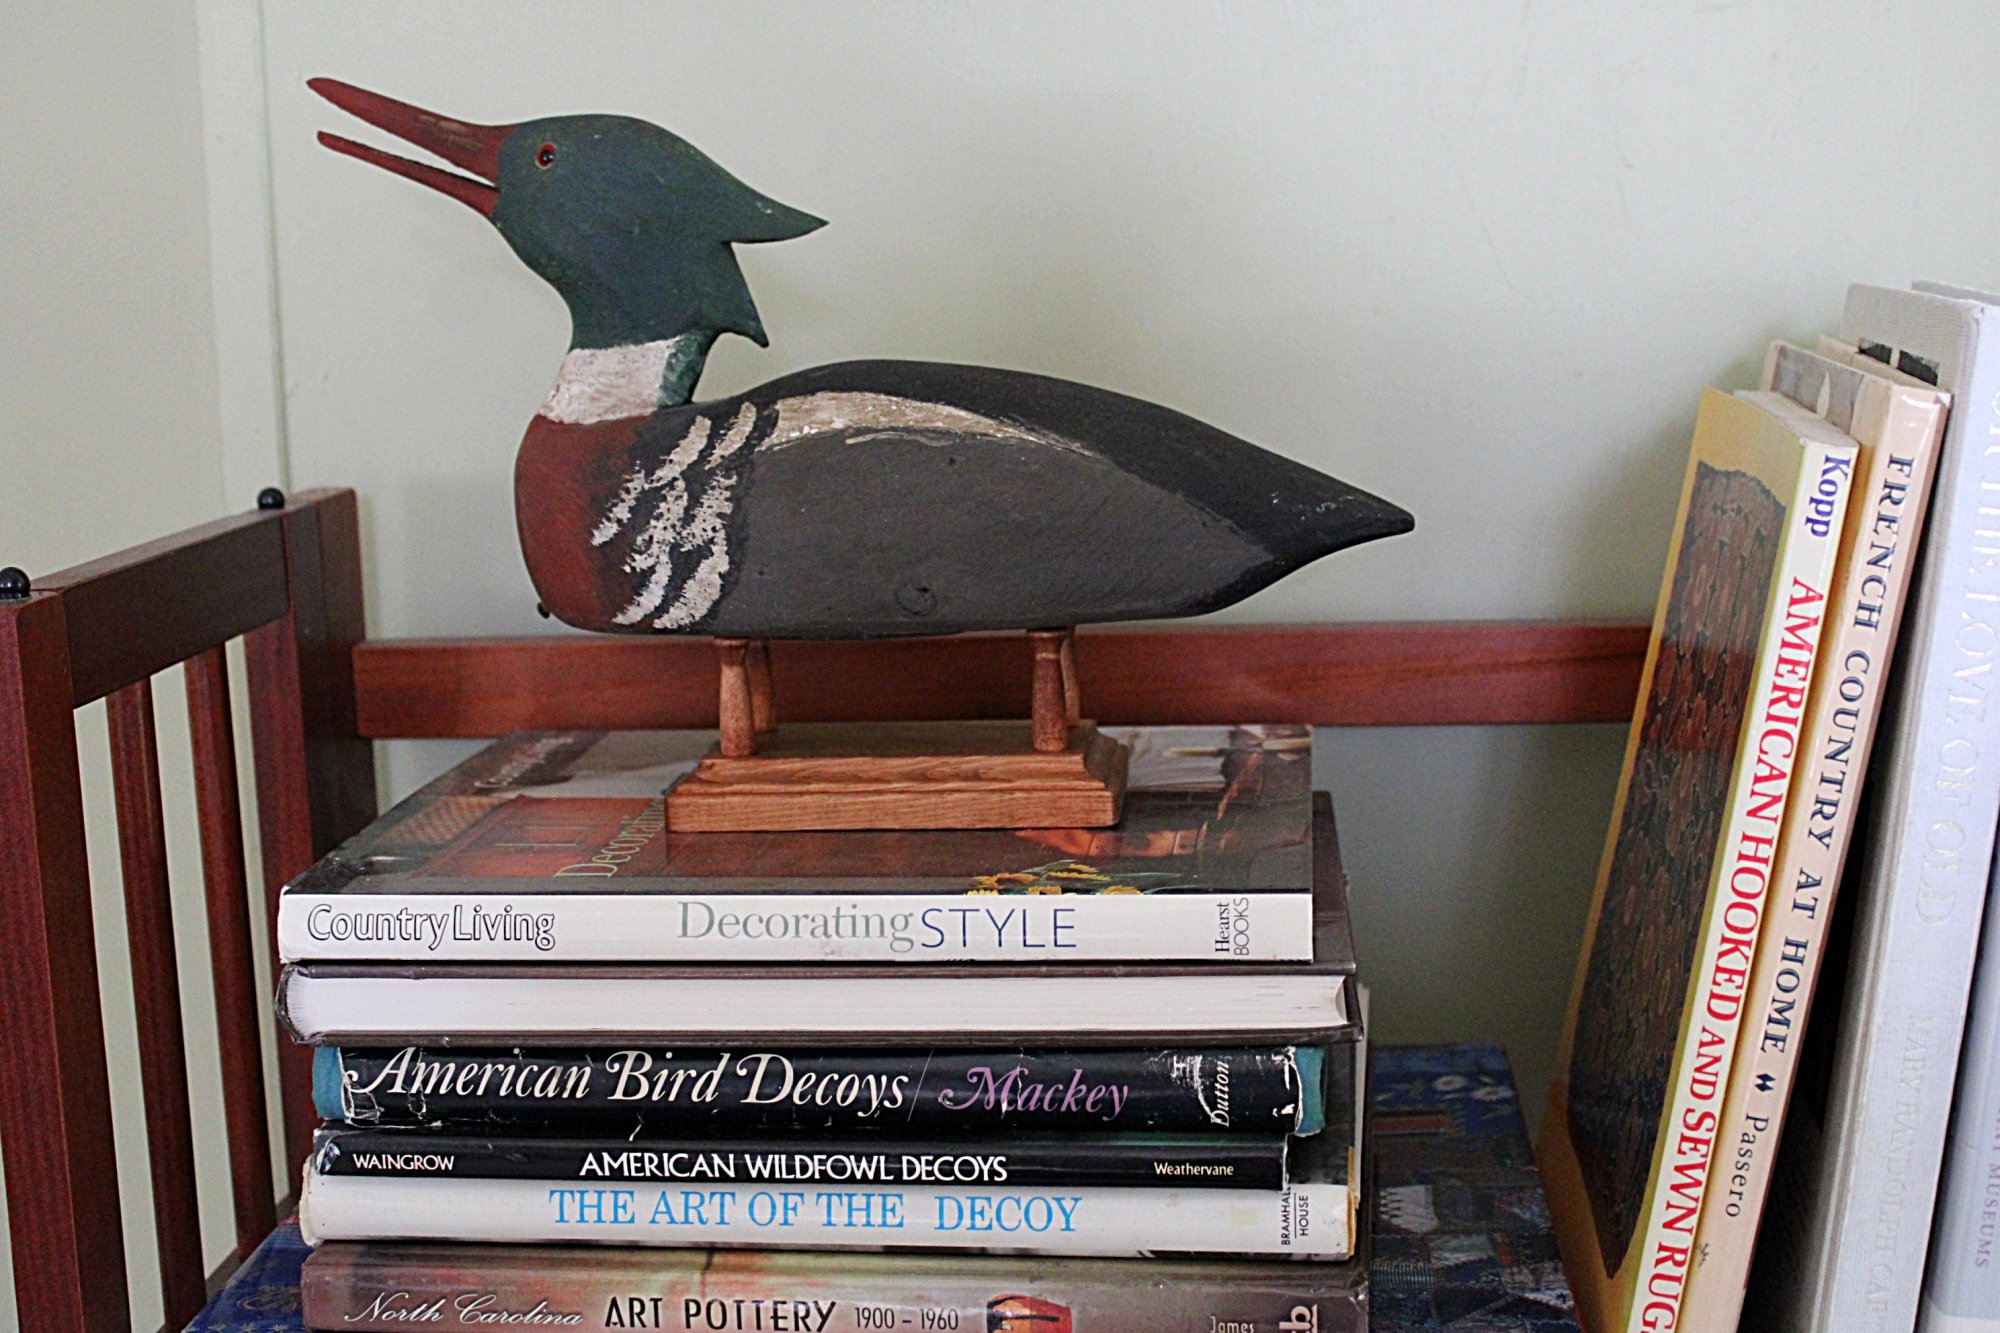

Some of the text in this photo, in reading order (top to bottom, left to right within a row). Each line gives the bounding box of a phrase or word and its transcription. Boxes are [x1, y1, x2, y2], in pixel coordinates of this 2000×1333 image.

[1946, 587, 2000, 724] LOVE
[1935, 739, 1979, 807] OF
[1726, 454, 1914, 1217] FRENCH COUNTRY AT HOME Passero
[1641, 454, 1852, 1333] Kopp AMERICAN HOOKED AND SEWN RUG
[1916, 820, 1966, 923] OLD
[307, 904, 556, 951] Country Living
[677, 901, 1077, 953] Decorating STYLE
[1215, 902, 1230, 953] Hearst
[1233, 897, 1250, 956] BOOKS
[343, 1047, 1129, 1121] American Bird Decoys Mackey
[1901, 1013, 1932, 1095] MARY
[1211, 1061, 1230, 1127] Dutton
[353, 1152, 1235, 1182] WAINGROW AMERICAN WILDFOWL DECOYS Weathervane
[1876, 1100, 1920, 1257] RANDOLPH
[549, 1189, 1083, 1232] THE ART OF THE DECOY
[1299, 1195, 1309, 1236] HOUSE
[1975, 1163, 2000, 1268] MUSEUMS
[344, 1292, 448, 1322] North
[454, 1294, 583, 1325] Carolina
[605, 1297, 663, 1328] ART
[684, 1299, 837, 1332] POTTERY
[855, 1307, 895, 1330] 1900
[919, 1308, 959, 1332] 1960
[1210, 1316, 1254, 1333] James
